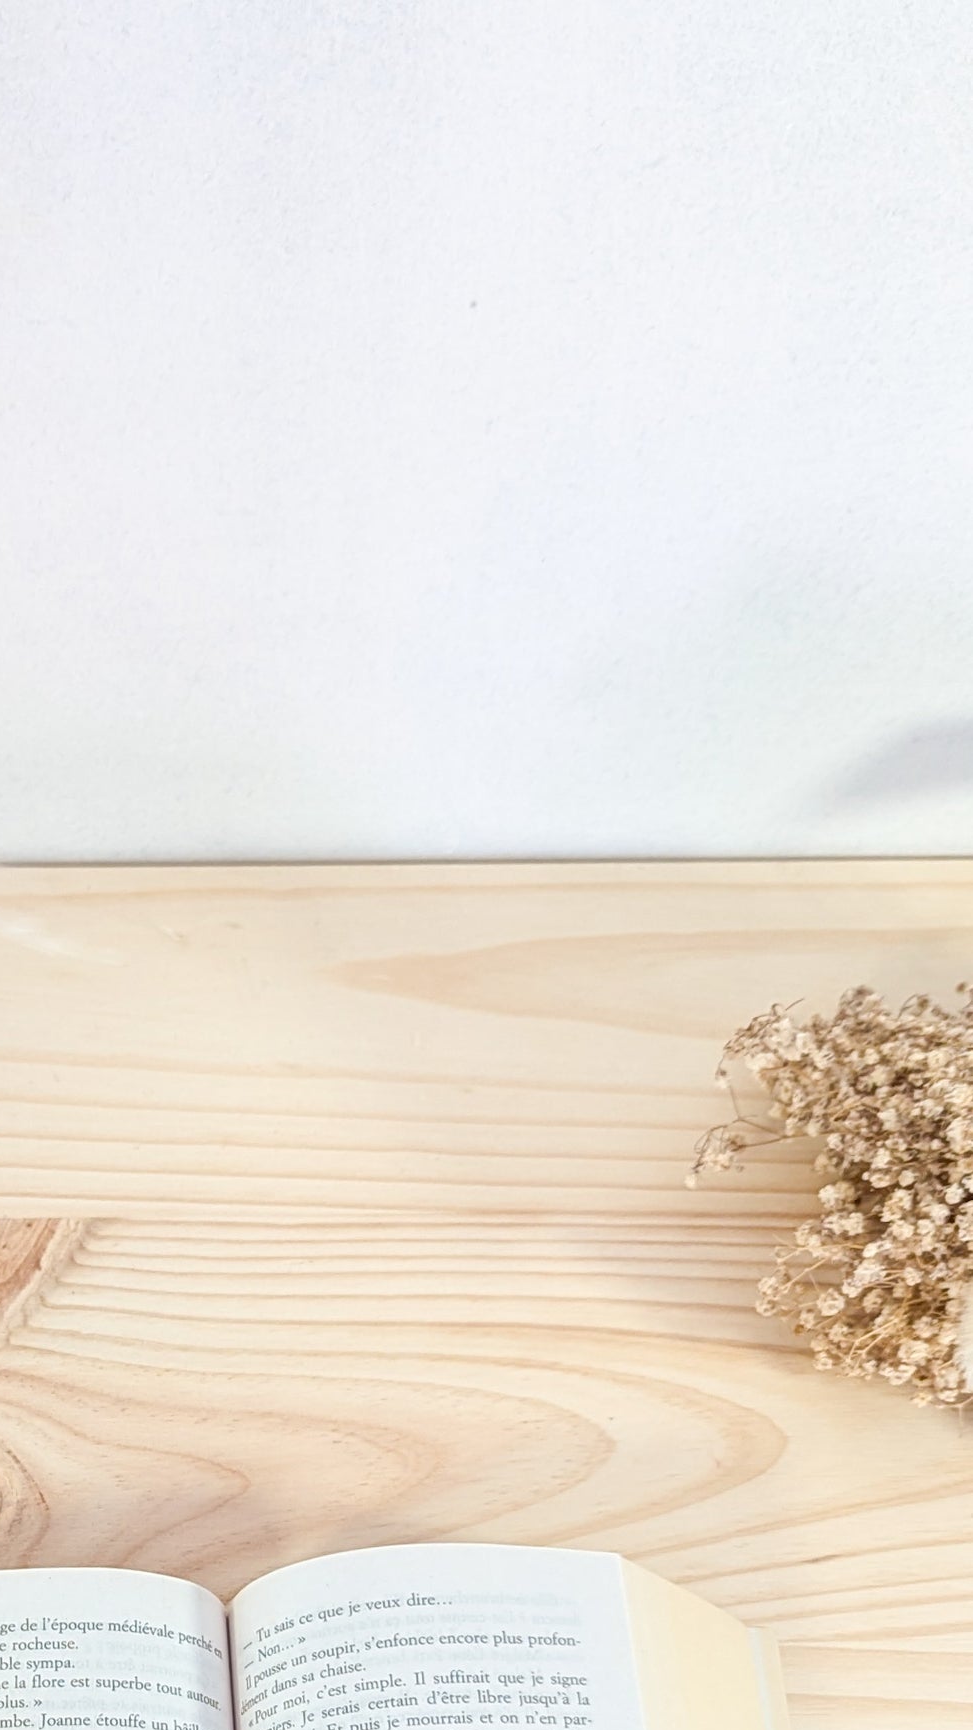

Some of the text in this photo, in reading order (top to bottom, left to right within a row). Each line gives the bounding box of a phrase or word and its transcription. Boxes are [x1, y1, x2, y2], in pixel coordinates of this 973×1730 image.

[19, 1617, 38, 1632] de
[42, 1616, 104, 1635] l'époque
[108, 1619, 175, 1640] médiévale
[273, 1598, 401, 1634] sais ce que je veux
[12, 1636, 79, 1651] rocheuse.
[311, 1630, 581, 1661] soupir, s'enfonce encore plus profon-
[26, 1659, 76, 1673] sympa.
[14, 1674, 27, 1689] la
[31, 1673, 66, 1689] flore
[70, 1677, 90, 1688] est
[95, 1675, 152, 1692] superbe
[156, 1682, 183, 1697] tout
[186, 1690, 221, 1711] autour.
[354, 1669, 587, 1693] simple. Il suffirait que je signe
[321, 1689, 591, 1719] serais certain d'être libre jusqu'à la
[38, 1713, 91, 1730] Joanne
[95, 1713, 147, 1729] étouffe
